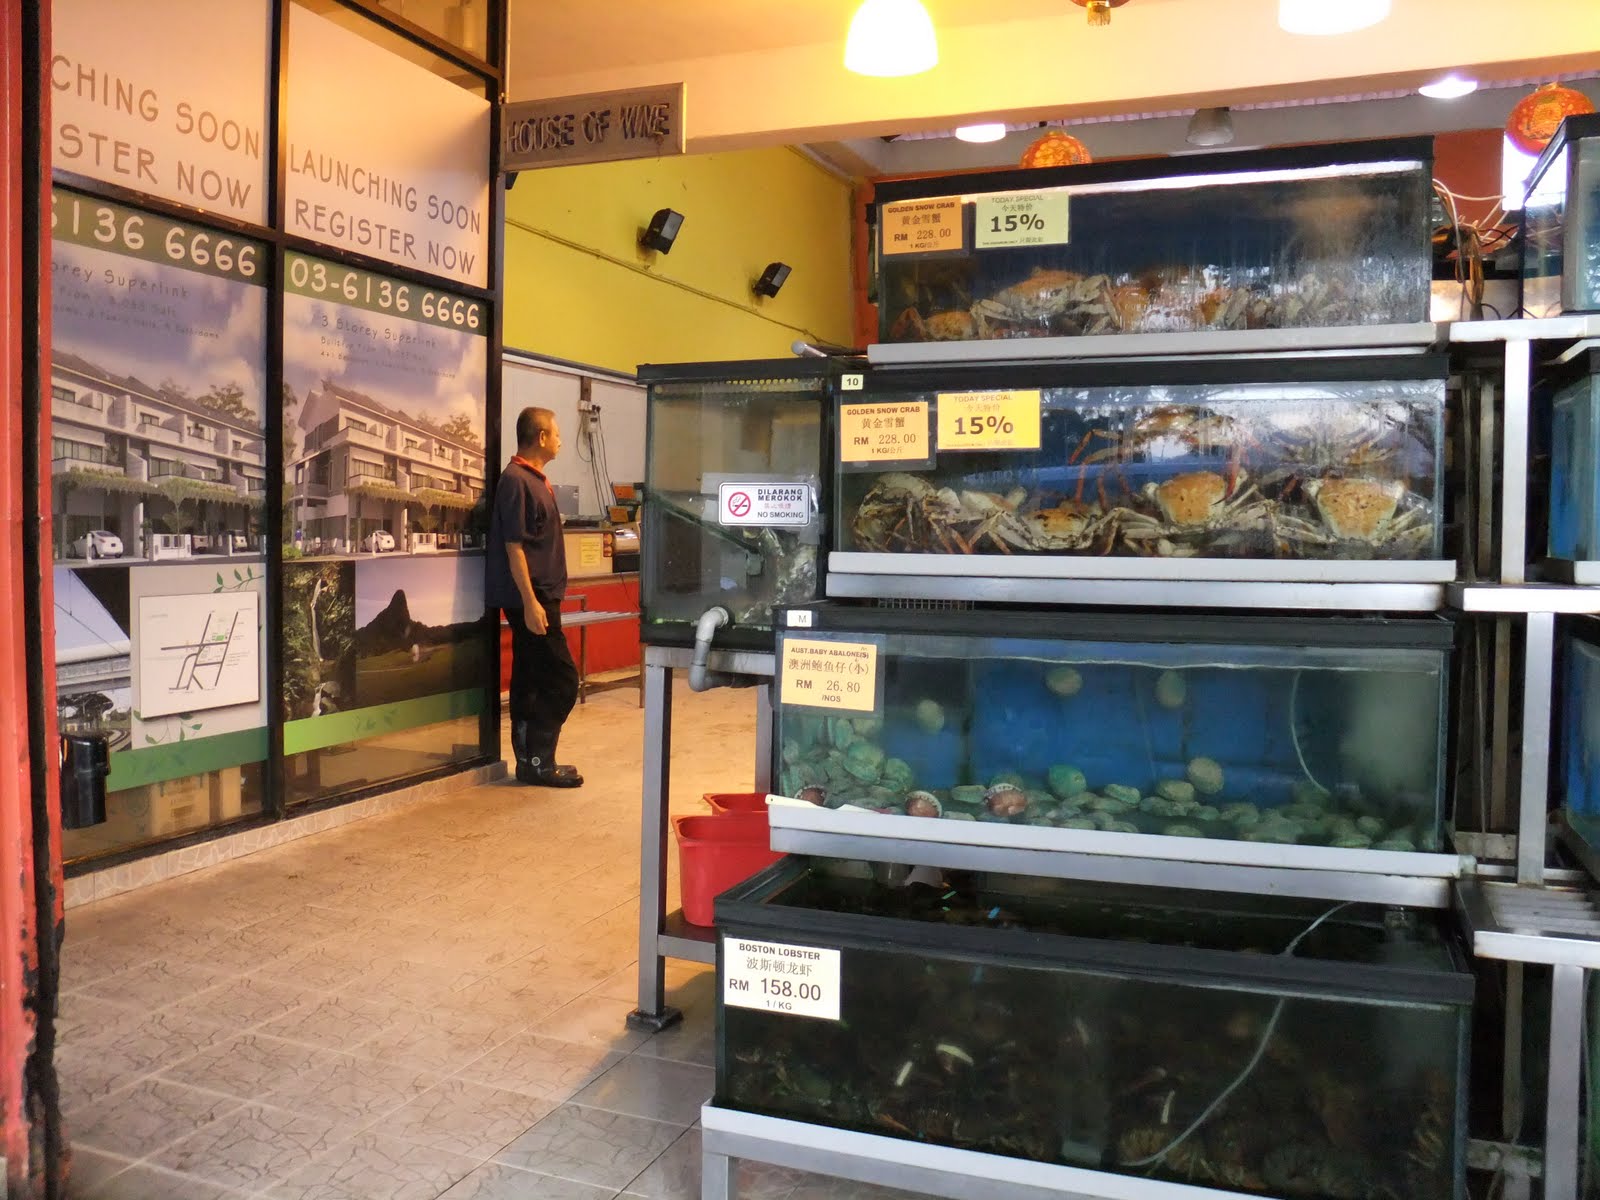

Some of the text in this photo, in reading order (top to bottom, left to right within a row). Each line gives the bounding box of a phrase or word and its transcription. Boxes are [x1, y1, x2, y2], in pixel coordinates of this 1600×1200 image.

[51, 55, 259, 160] CHING SOON
[506, 102, 670, 153] HOUSE OF WINE
[59, 124, 251, 209] STER NOW
[290, 143, 480, 235] LAUNCHING SOON
[1015, 194, 1044, 202] SPECIAL
[888, 201, 955, 213] GOLDEN SNOW CRAB
[991, 213, 1045, 232] 15%
[52, 194, 256, 276] 136 6666
[295, 198, 475, 275] REGISTER NOW
[894, 228, 951, 241] RM 228.00
[104, 269, 190, 299] Superlink
[291, 258, 479, 328] 03-6136 6666
[321, 315, 329, 327] 3
[336, 317, 378, 339] Storey
[846, 378, 859, 386] 10
[954, 394, 1013, 403] TODAY SPECIAL
[955, 415, 1014, 435] 15%
[853, 433, 917, 445] RM 228.00
[798, 615, 807, 623] M
[796, 679, 861, 693] RM 26.80
[739, 943, 820, 960] BOSTON LOBSTER
[746, 957, 813, 977] 波斯顿龙虾
[729, 978, 821, 1001] RM 158.00
